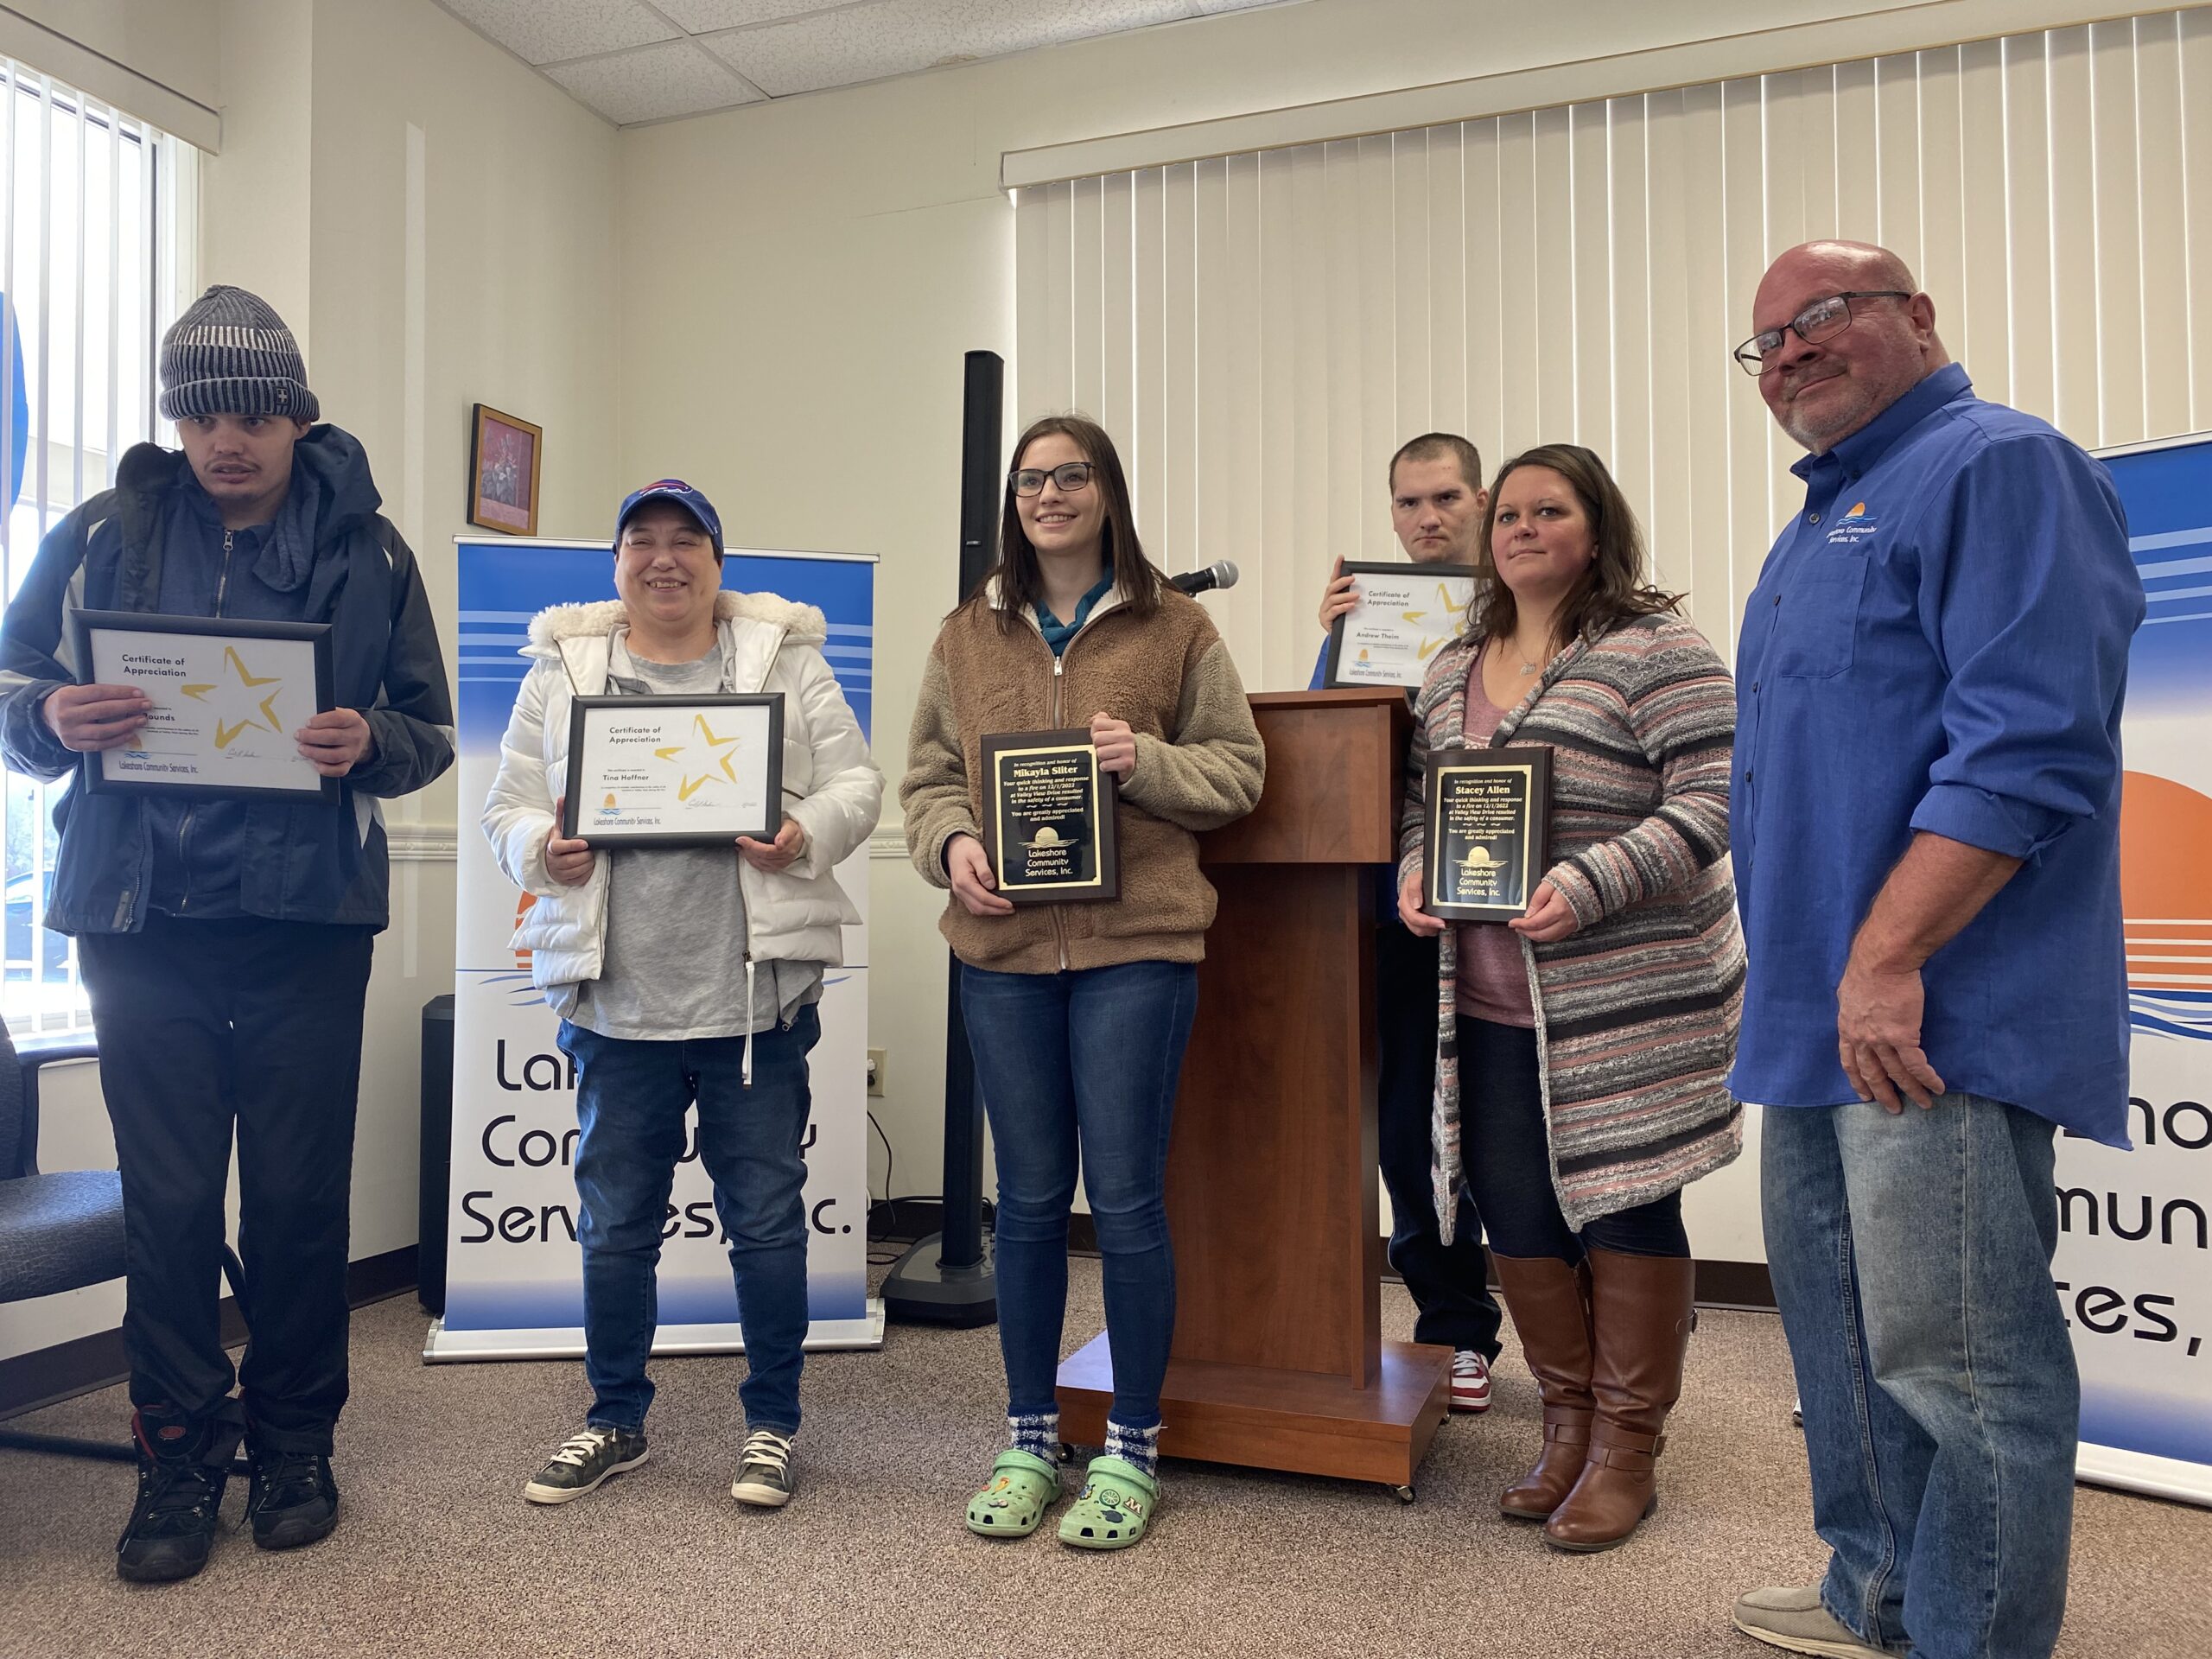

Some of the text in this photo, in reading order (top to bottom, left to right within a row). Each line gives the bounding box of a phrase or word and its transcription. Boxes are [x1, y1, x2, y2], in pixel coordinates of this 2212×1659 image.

[122, 654, 172, 664] Certificate
[124, 665, 187, 677] Appreciation
[118, 760, 143, 771] Lakeshore
[143, 761, 168, 772] Community
[1014, 766, 1078, 778] Mikayla Sliter
[1455, 785, 1510, 796] Stacey Allen
[1028, 849, 1067, 858] Lakeshore
[1027, 858, 1069, 868] Community
[1025, 867, 1073, 877] Services, Inc.
[1460, 868, 1497, 877] Lakeshore
[1459, 877, 1497, 887] Community
[1456, 887, 1501, 897] Services, Inc.
